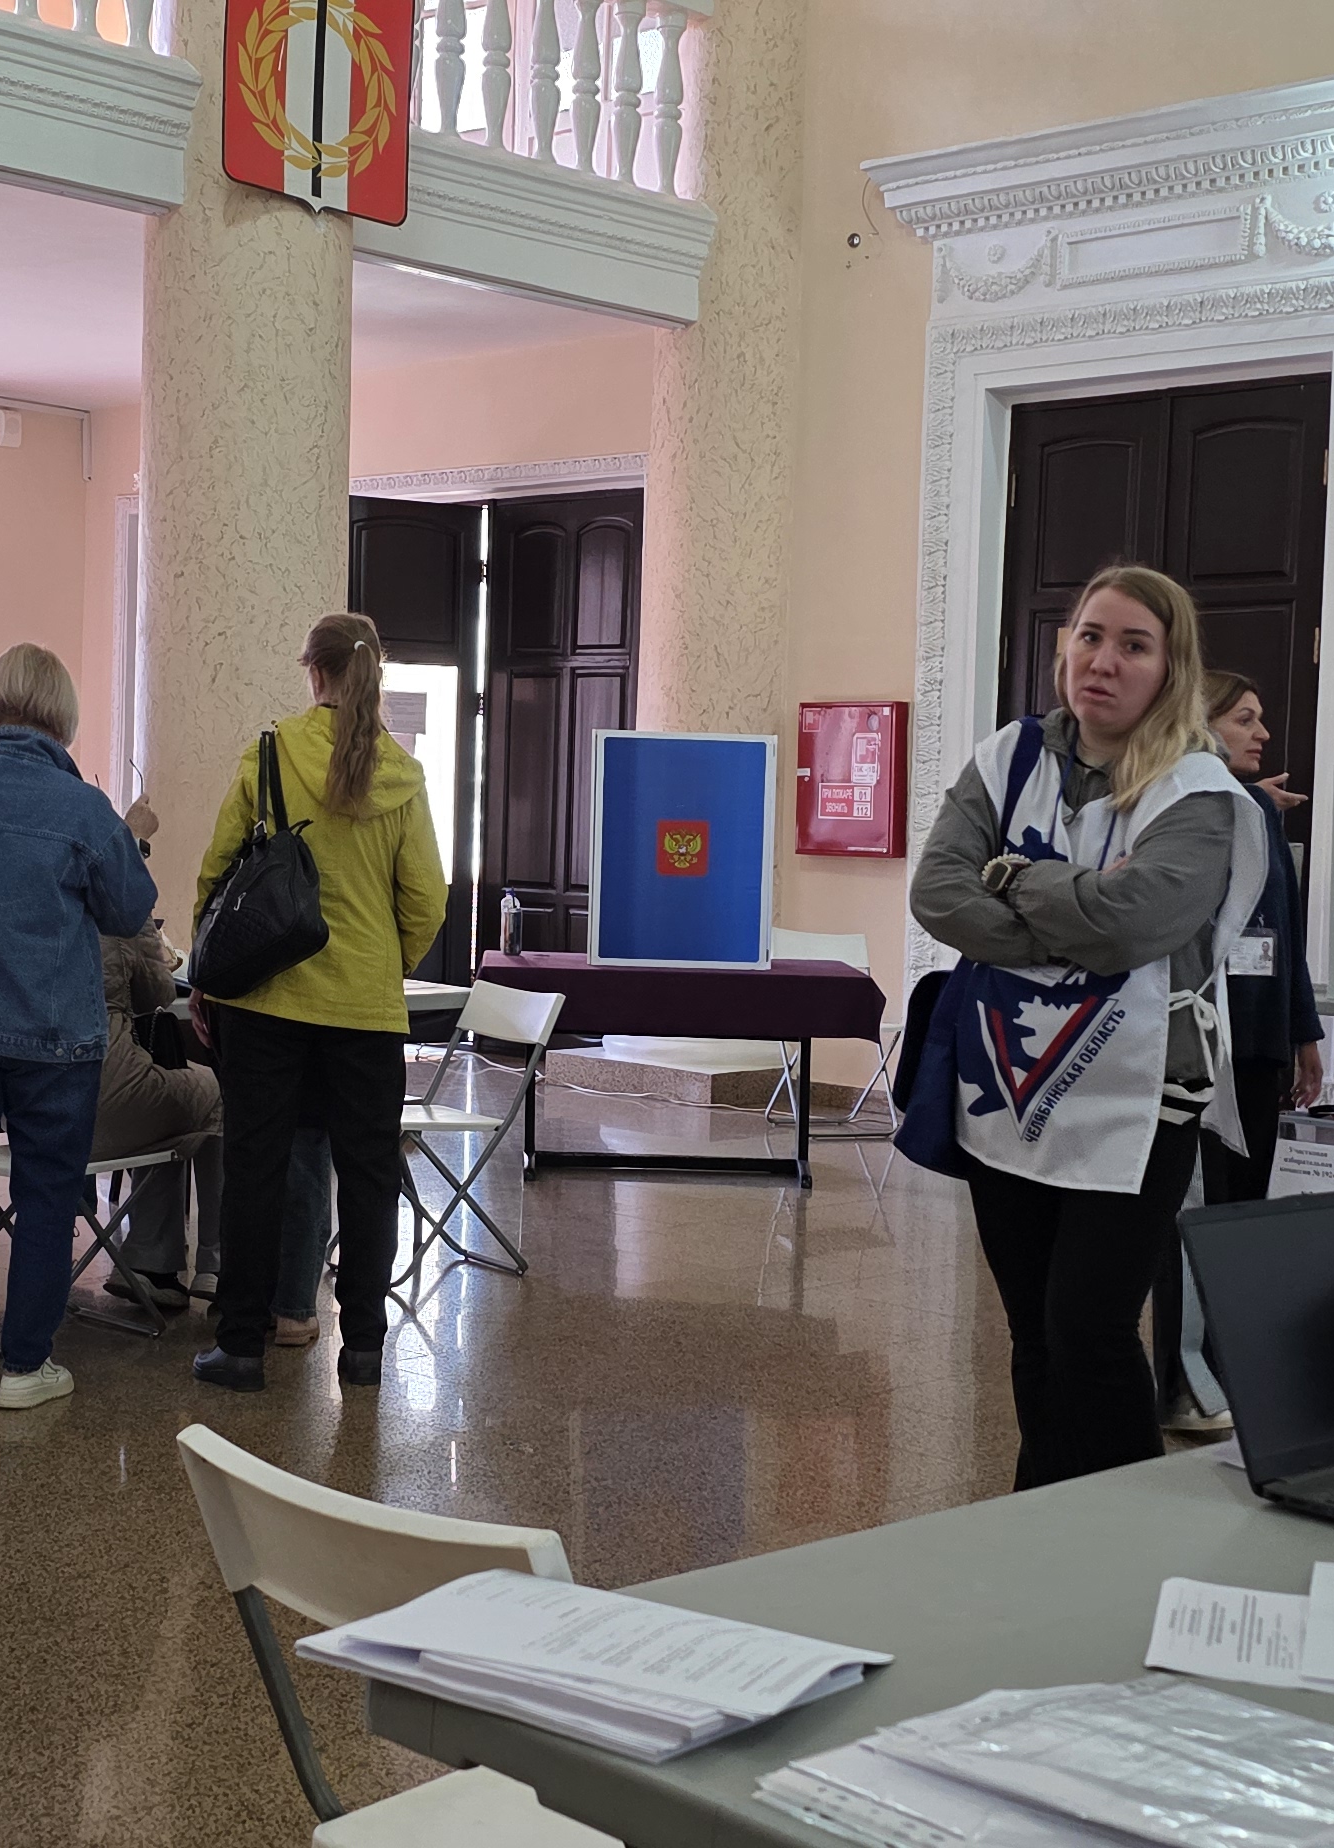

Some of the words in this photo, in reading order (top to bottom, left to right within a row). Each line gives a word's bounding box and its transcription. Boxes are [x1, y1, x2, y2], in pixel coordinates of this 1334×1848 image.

[856, 806, 869, 816] 112
[1024, 1062, 1086, 1143] ЧЕЛЯБИНСКАЯ
[1079, 1008, 1126, 1064] ОБЛАСТЬ
